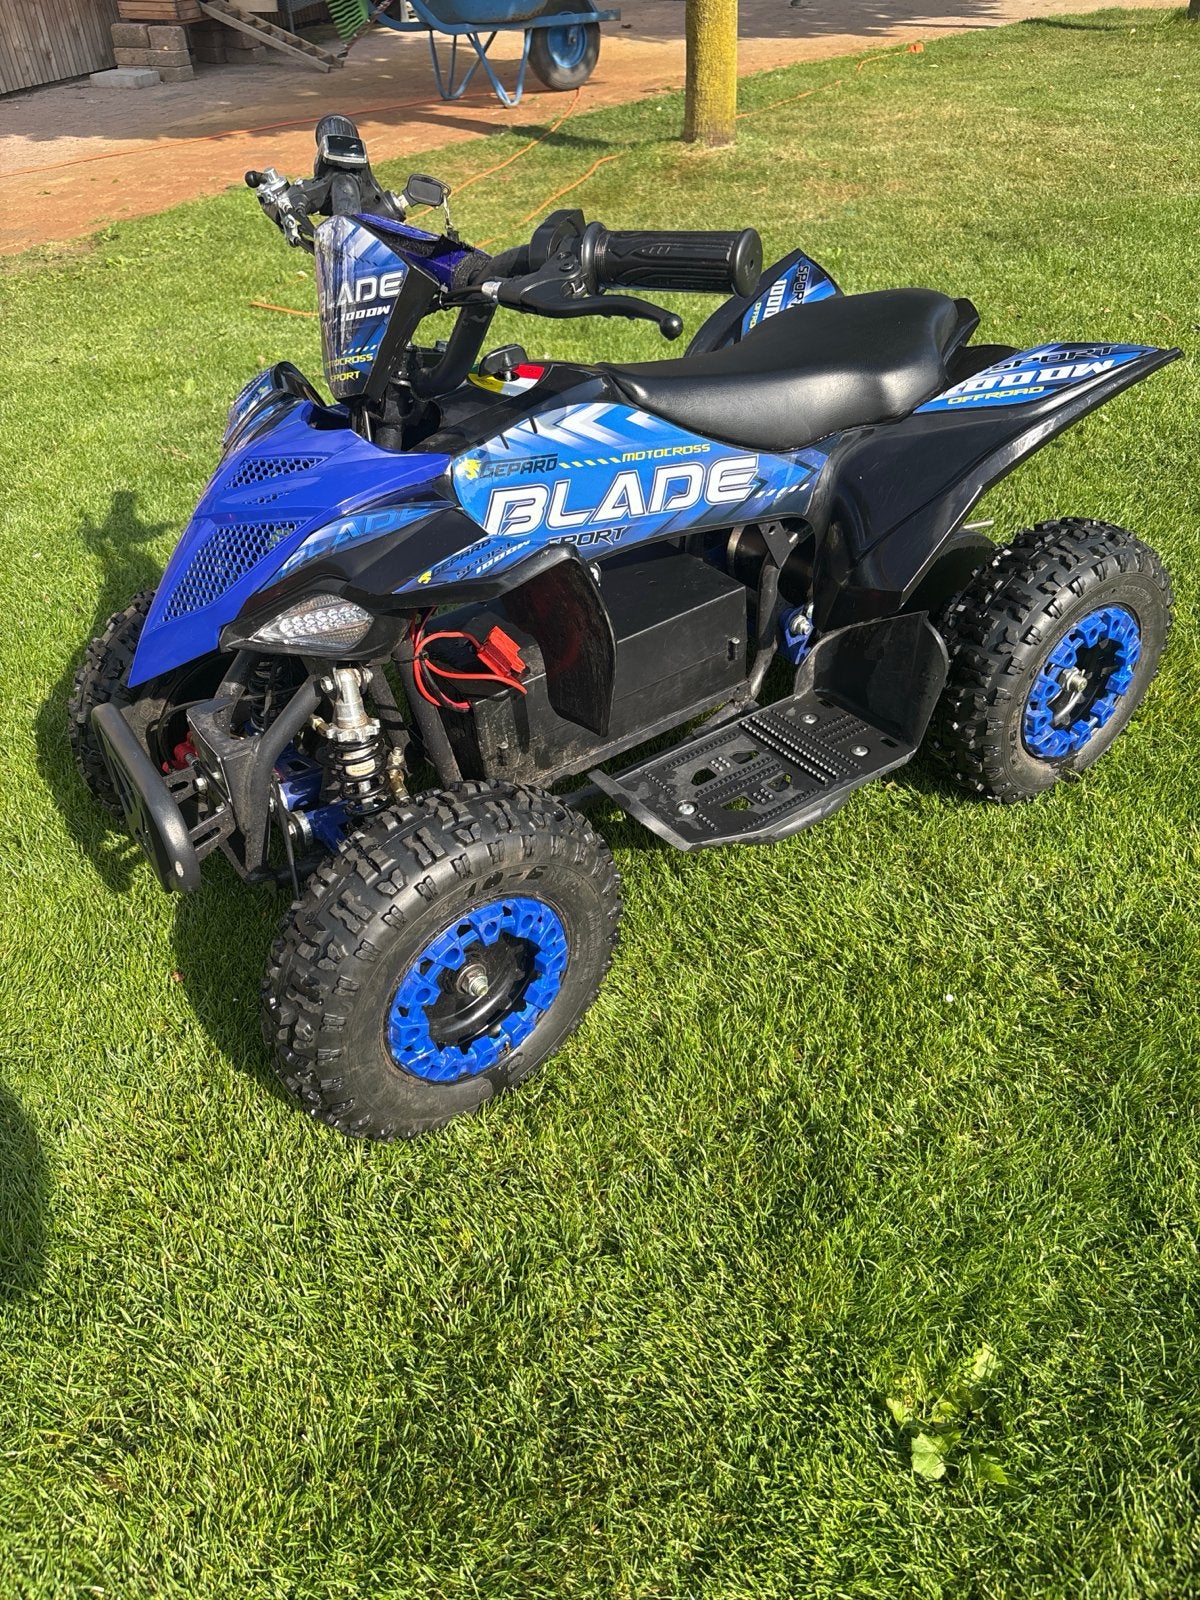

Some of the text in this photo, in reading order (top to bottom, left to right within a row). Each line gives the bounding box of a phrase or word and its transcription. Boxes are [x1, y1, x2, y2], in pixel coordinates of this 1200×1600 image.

[330, 371, 360, 383] SPORT
[989, 346, 1119, 373] SPORT
[947, 386, 1045, 405] OFFROAD
[479, 443, 711, 480] GEPARD MOTOCROSS
[482, 454, 761, 537] BLADE
[432, 538, 492, 575] GEPARD
[456, 542, 514, 578] SPORT
[475, 539, 531, 575] 1000W
